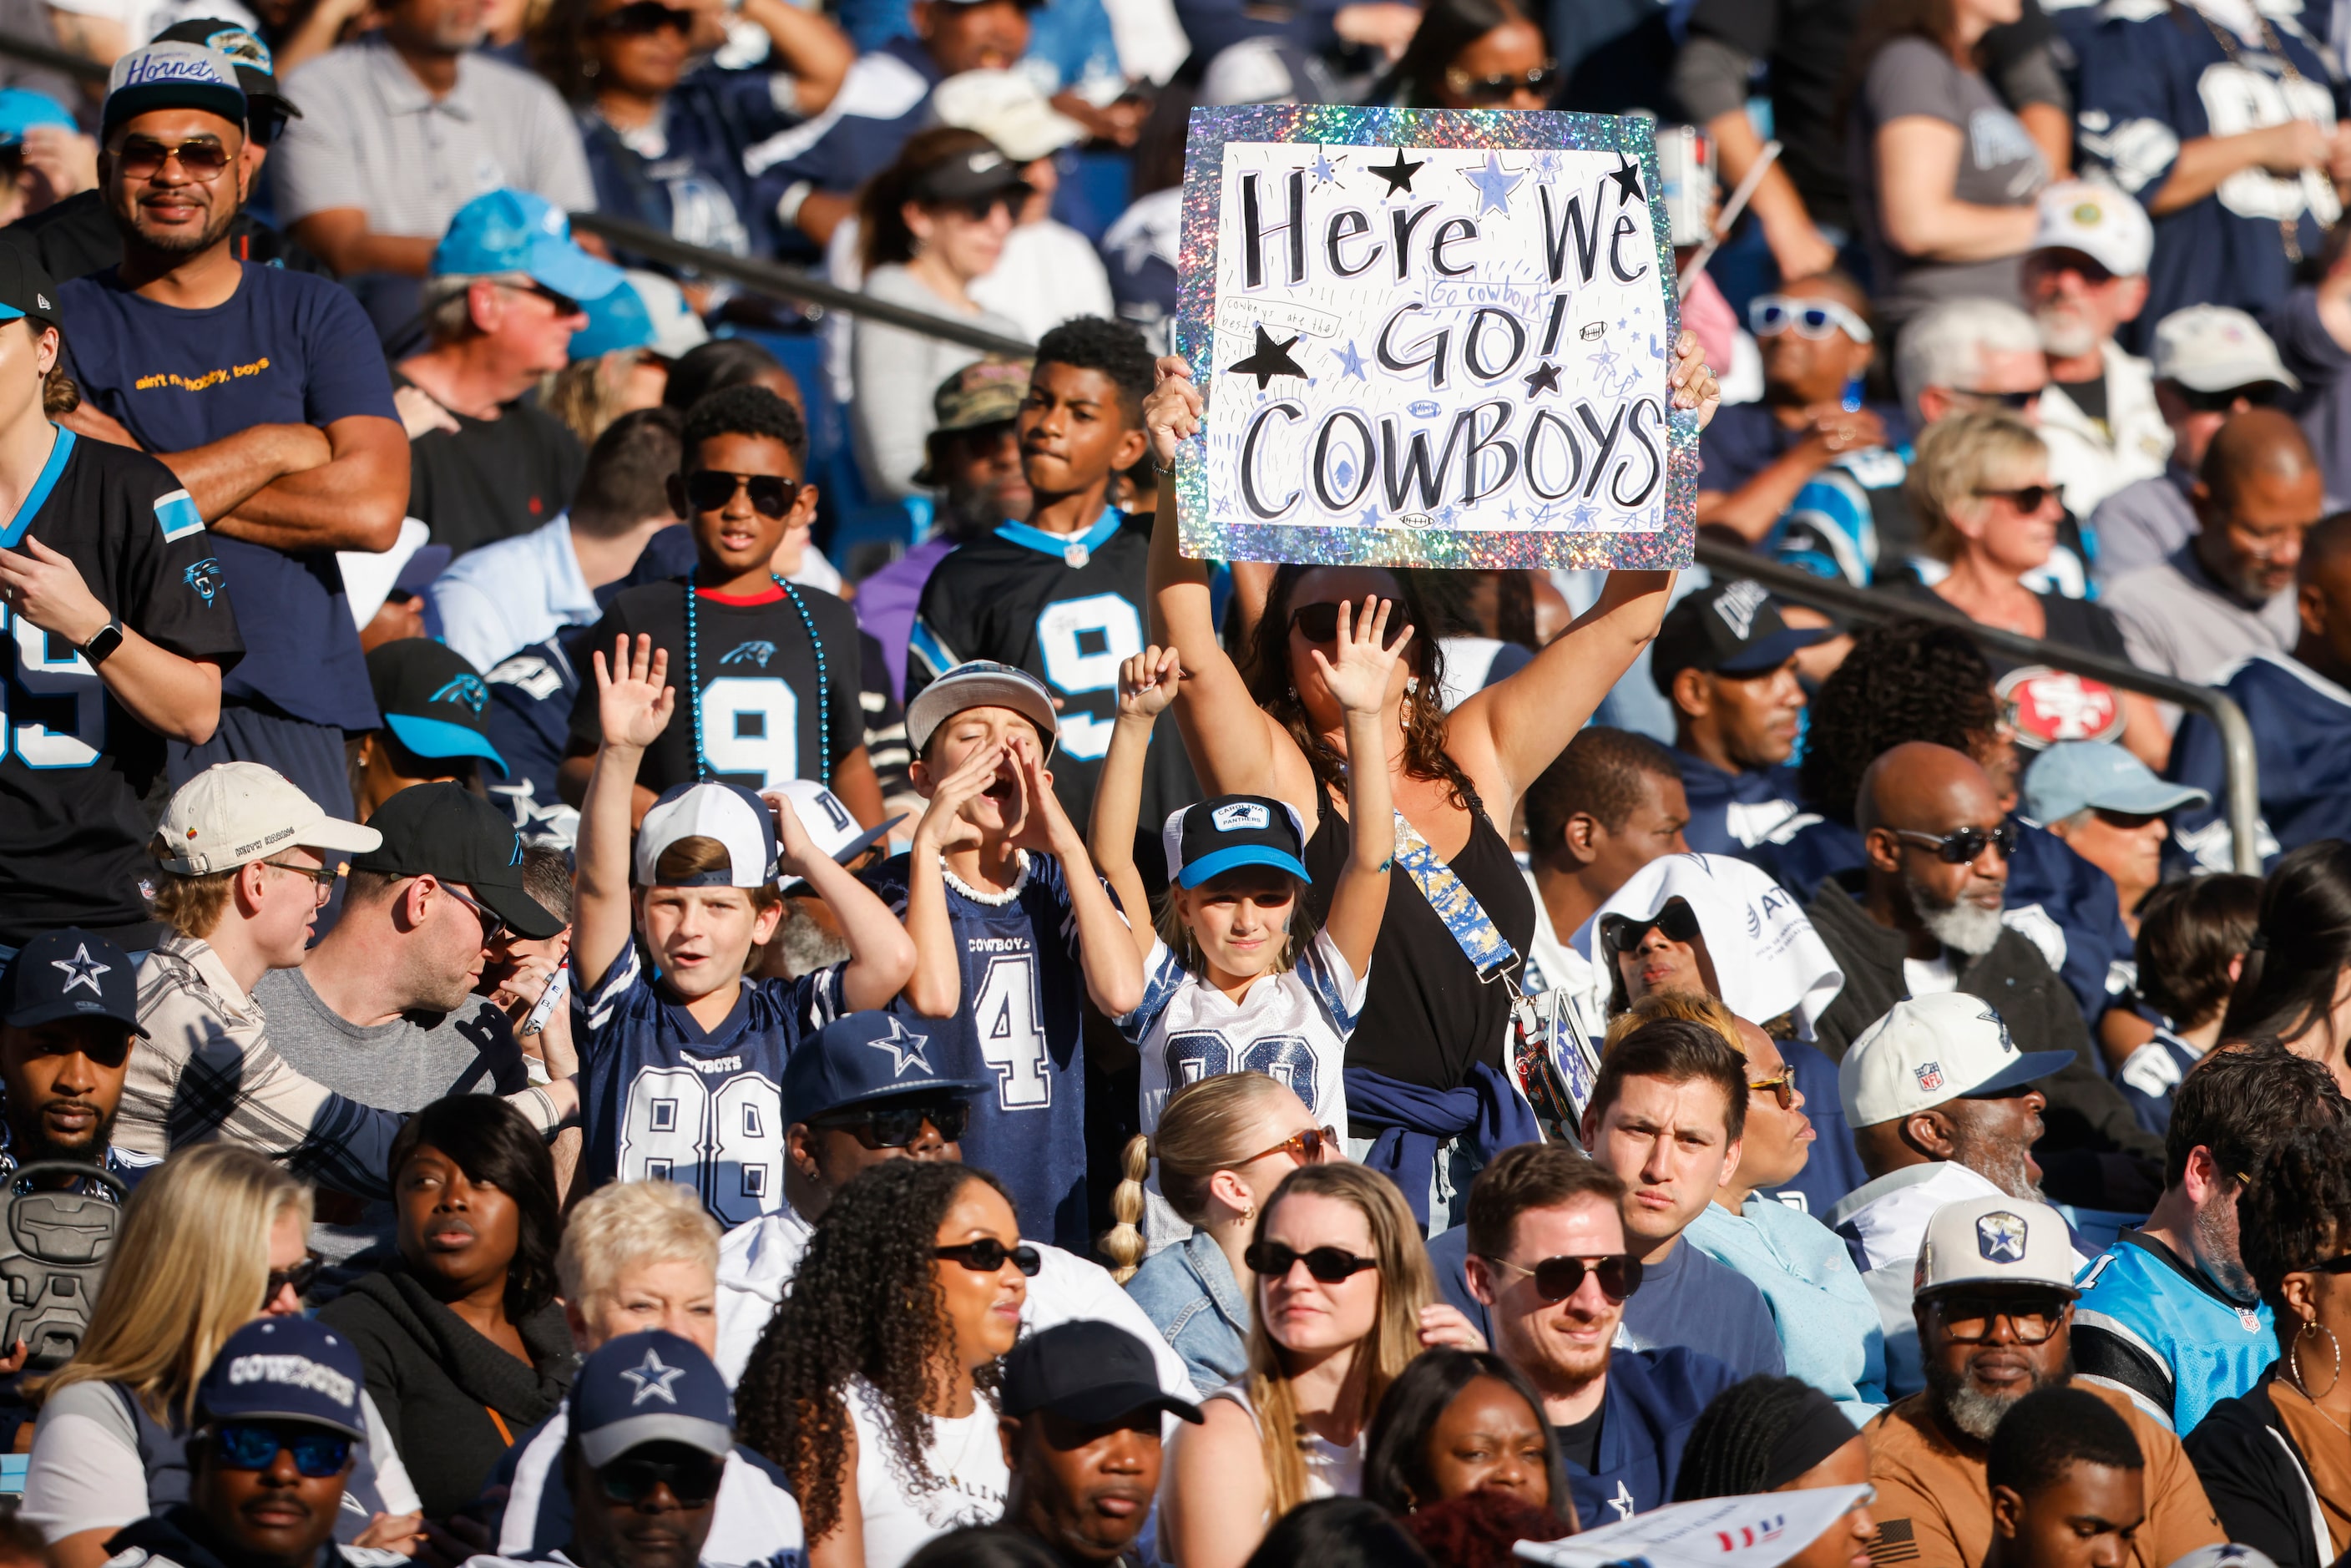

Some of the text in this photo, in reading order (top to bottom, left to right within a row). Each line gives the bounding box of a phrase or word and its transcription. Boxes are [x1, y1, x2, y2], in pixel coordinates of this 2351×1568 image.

[126, 53, 225, 85] Hornets
[1242, 169, 1648, 289] Here We
[1227, 299, 1275, 325] cowboys
[1468, 275, 1550, 316] cowboys
[1221, 314, 1251, 335] best.
[1376, 293, 1570, 387] GO!
[232, 357, 270, 377] boys
[1241, 397, 1664, 520] COWBOYS
[1035, 590, 1155, 762] 9
[695, 675, 799, 790] 9
[1217, 804, 1264, 816] CAROLINA
[1222, 817, 1262, 826] PANTHERS
[973, 952, 1051, 1111] 4
[1920, 1073, 1942, 1089] NFL
[616, 1065, 786, 1222] 88
[2244, 1315, 2259, 1331] NFL
